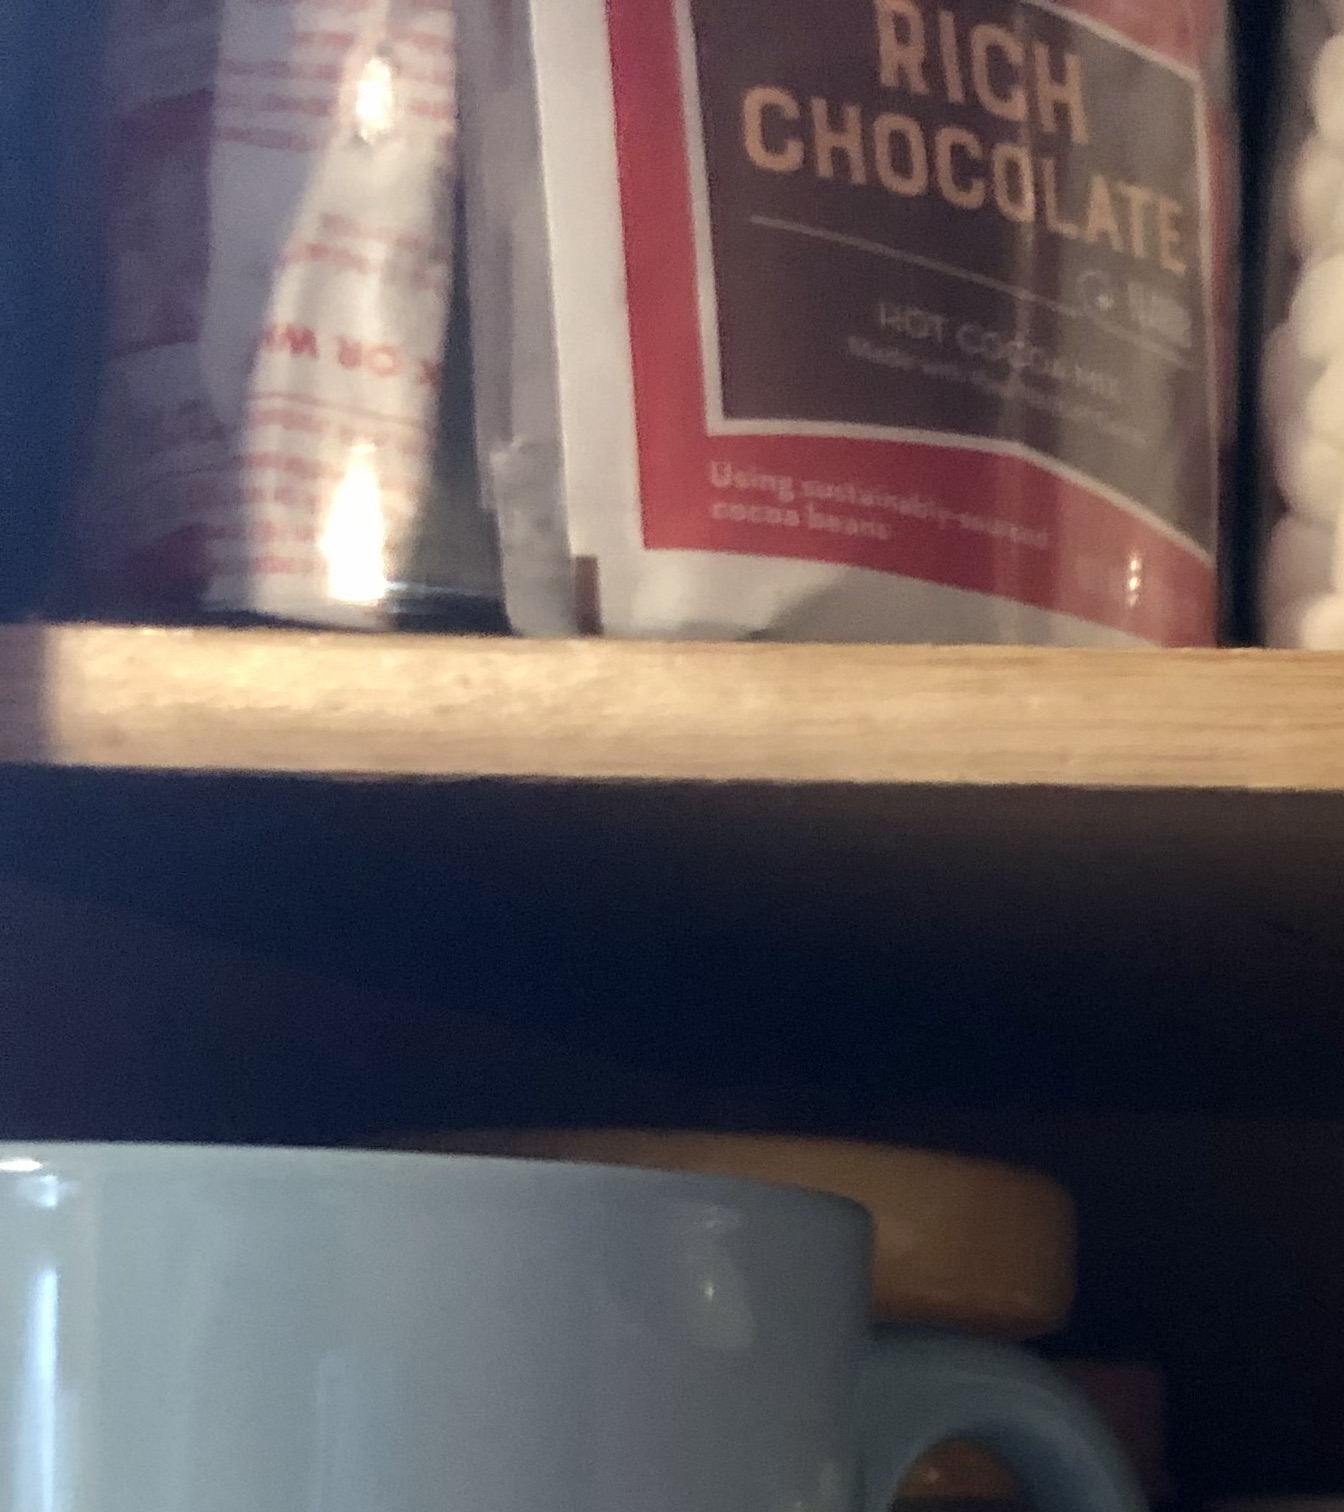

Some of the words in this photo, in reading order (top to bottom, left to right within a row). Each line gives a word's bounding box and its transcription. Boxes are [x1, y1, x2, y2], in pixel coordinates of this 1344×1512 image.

[873, 0, 1090, 145] RICH
[741, 86, 1188, 275] CHOCOLATE
[710, 461, 795, 502] Using
